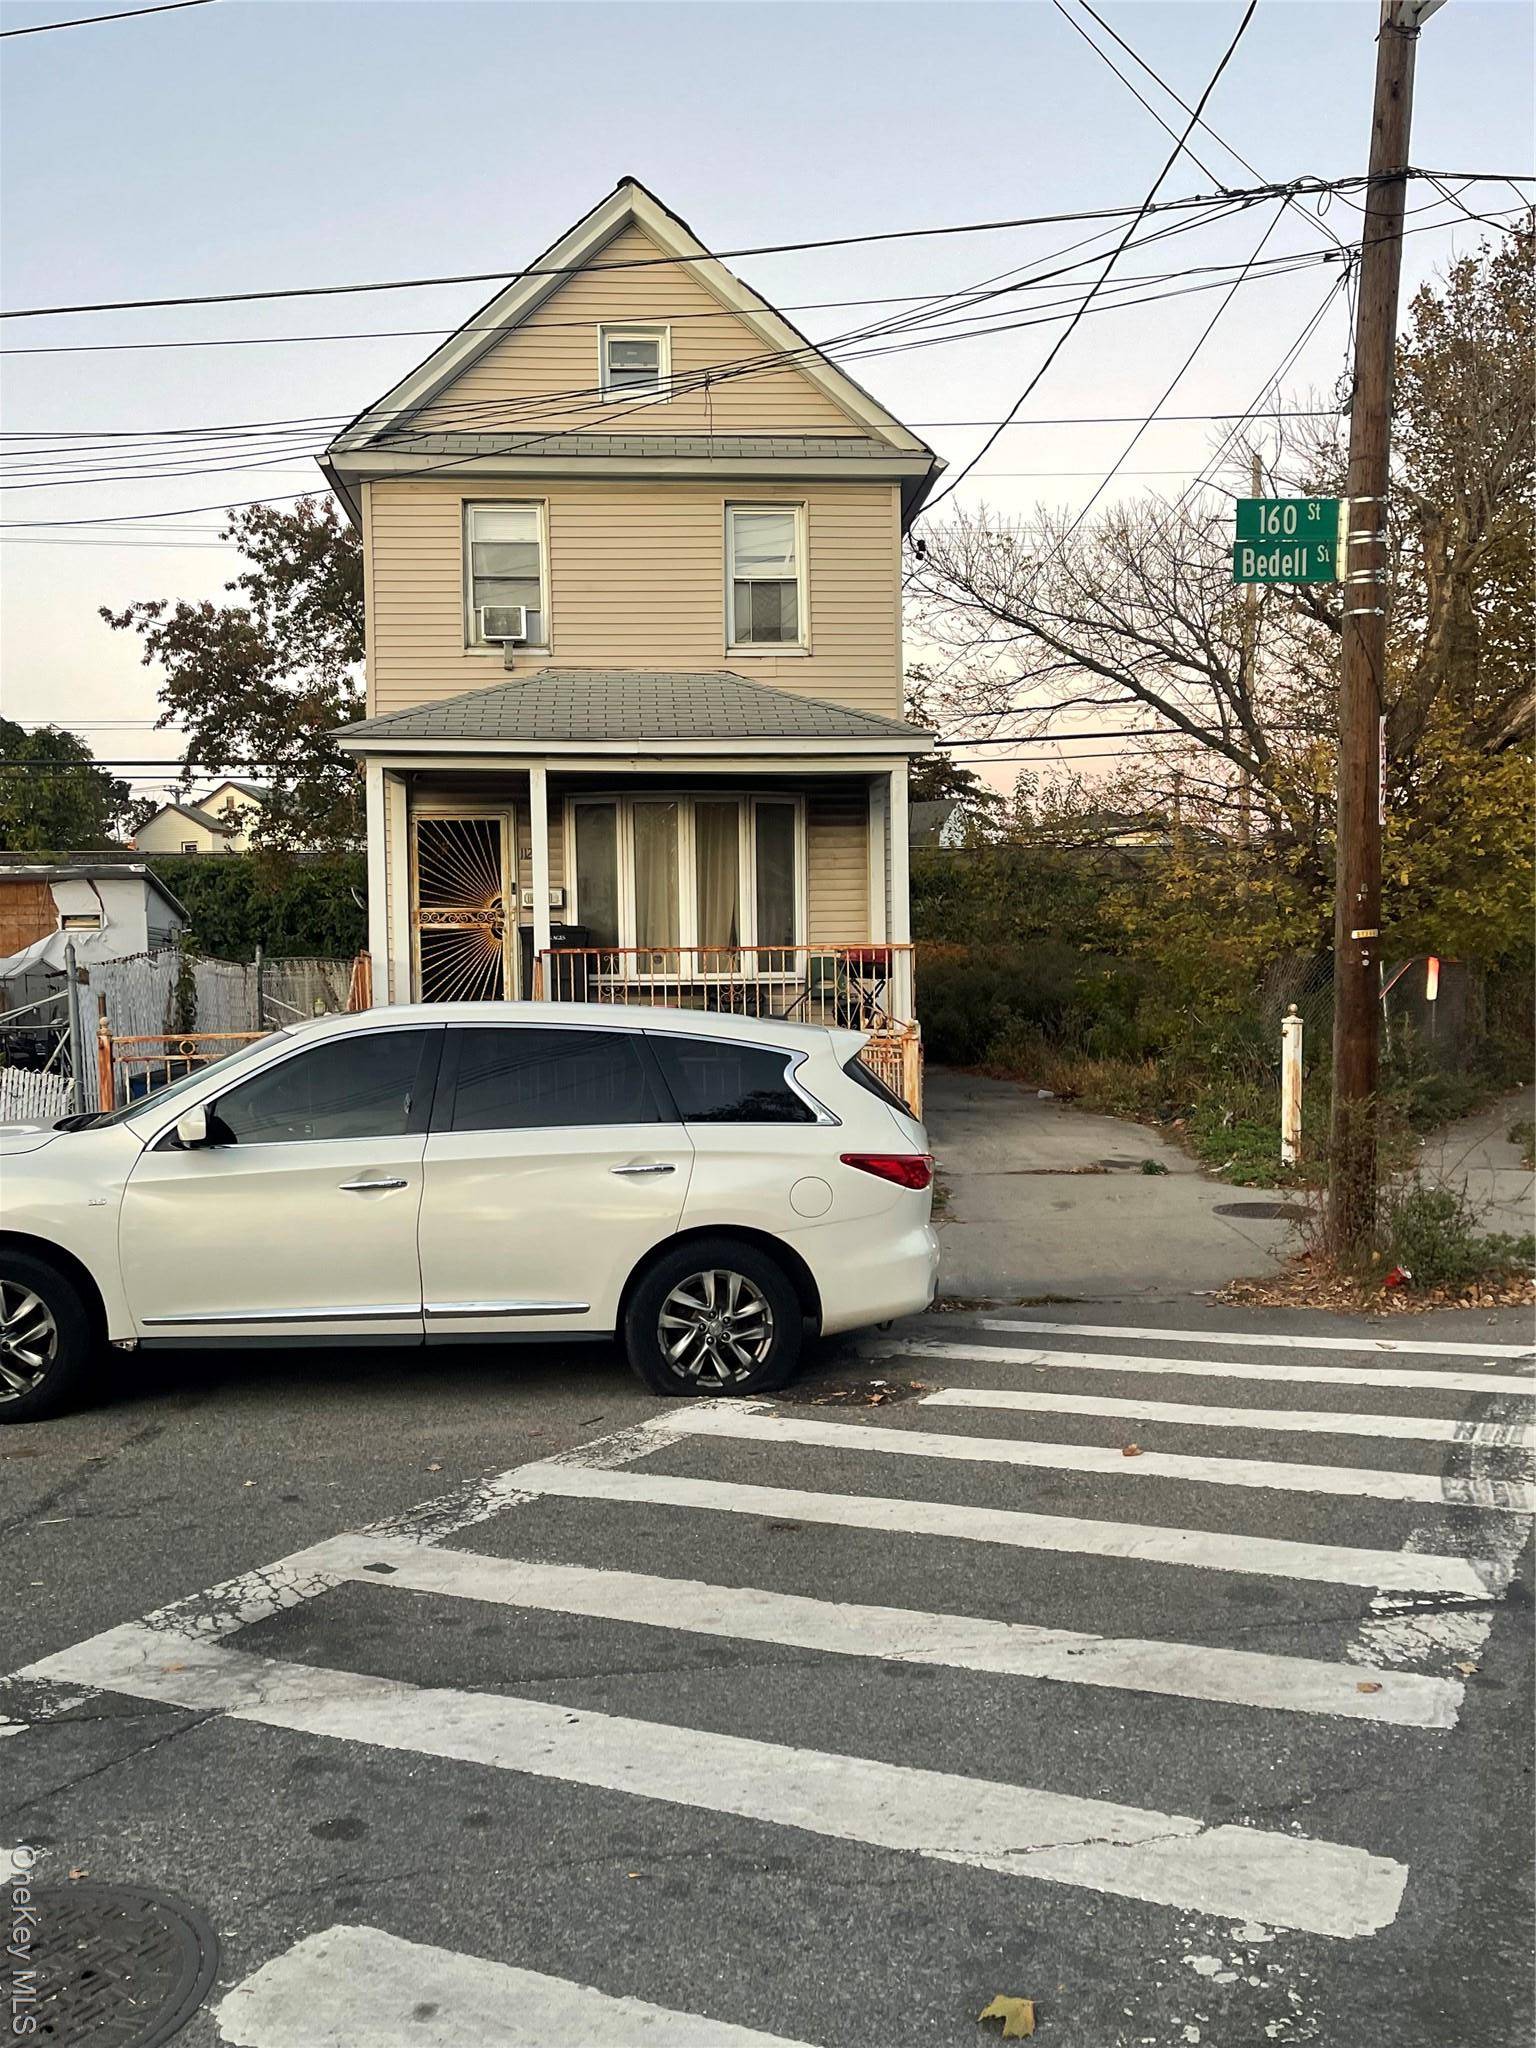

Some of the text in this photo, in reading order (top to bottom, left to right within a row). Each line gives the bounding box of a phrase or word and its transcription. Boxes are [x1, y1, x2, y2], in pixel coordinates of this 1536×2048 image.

[1259, 503, 1320, 534] 160 St
[1242, 548, 1307, 577] Bedell
